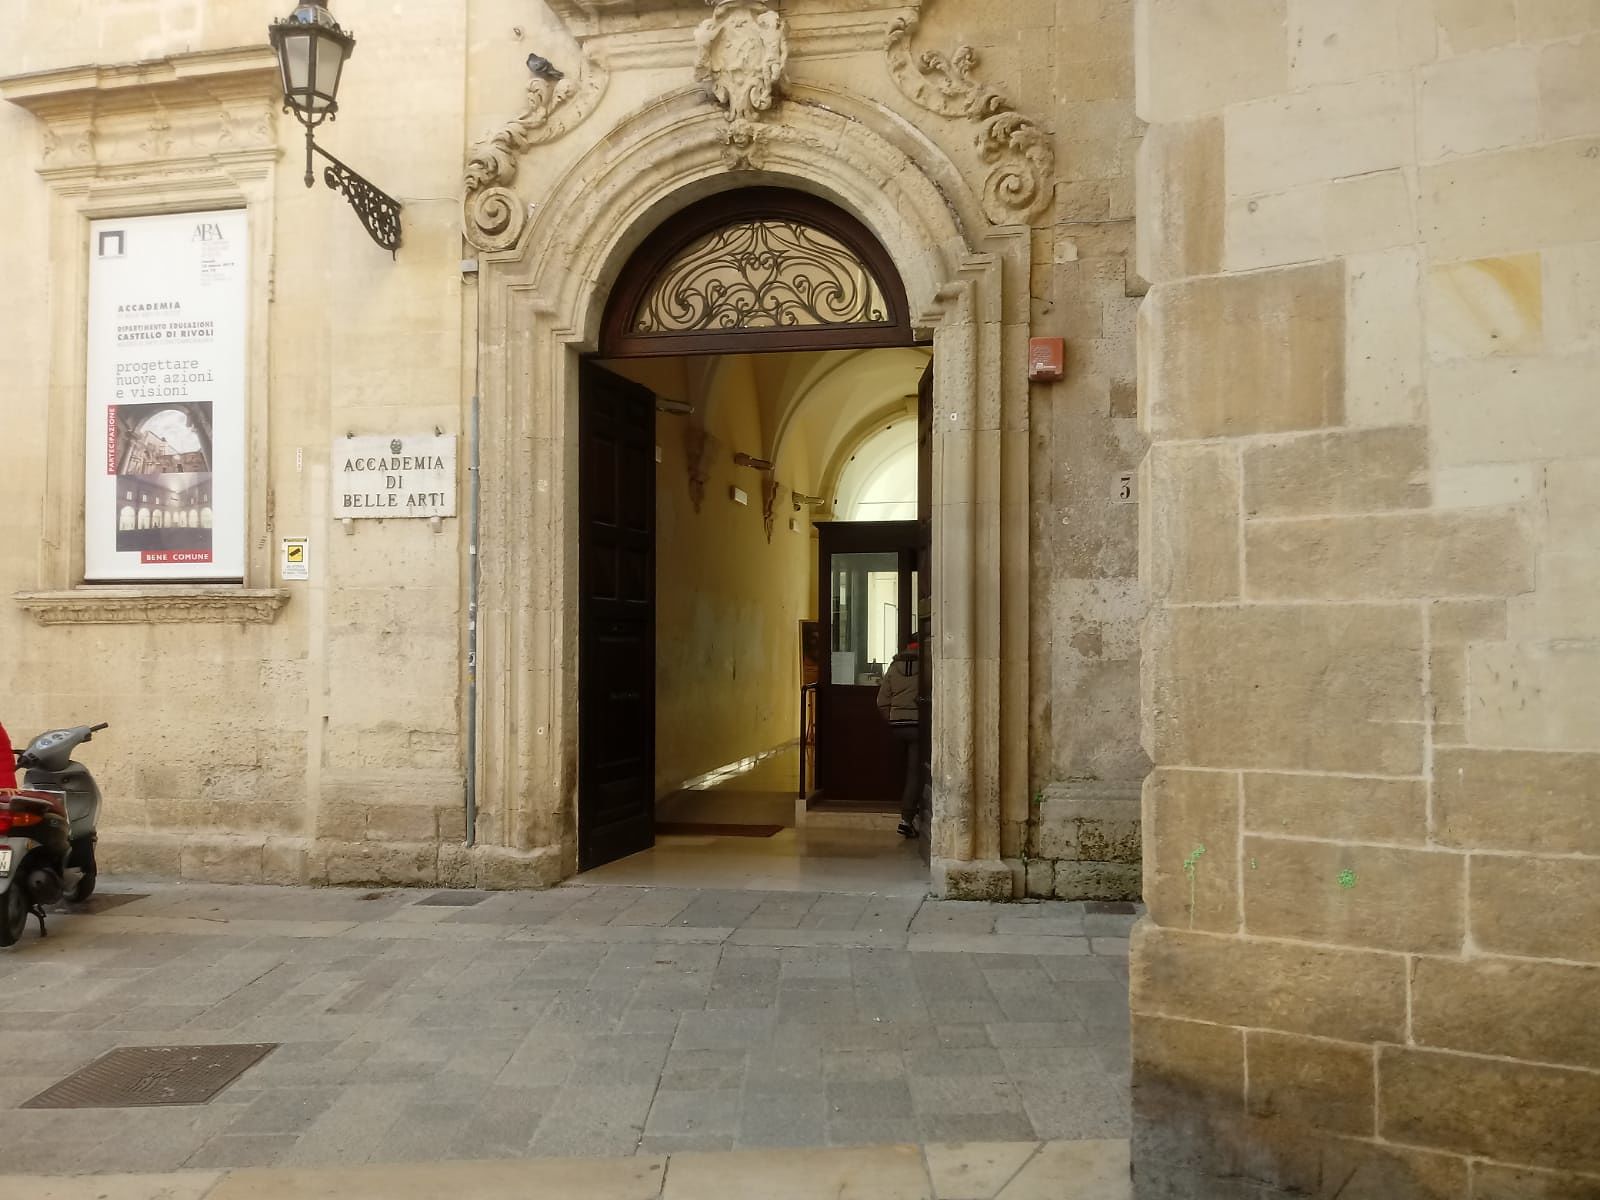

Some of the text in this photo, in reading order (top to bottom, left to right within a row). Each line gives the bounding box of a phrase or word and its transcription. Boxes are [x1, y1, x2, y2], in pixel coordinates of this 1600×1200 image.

[118, 301, 181, 312] ACCADEMIA
[117, 321, 214, 333] DIPARTIMENTO EDUCAZIONE
[117, 329, 214, 341] CASTELLO DI RIVOLI
[116, 360, 199, 375] progettare
[116, 370, 214, 386] nuove azioni
[116, 385, 188, 398] e visioni
[108, 407, 116, 472] PARTECIPAZIONE
[343, 456, 444, 472] ACCADEMIA
[386, 475, 403, 489] DI
[1120, 477, 1130, 499] 3
[343, 493, 445, 508] BELLE ARTI
[172, 553, 209, 561] COMUNE
